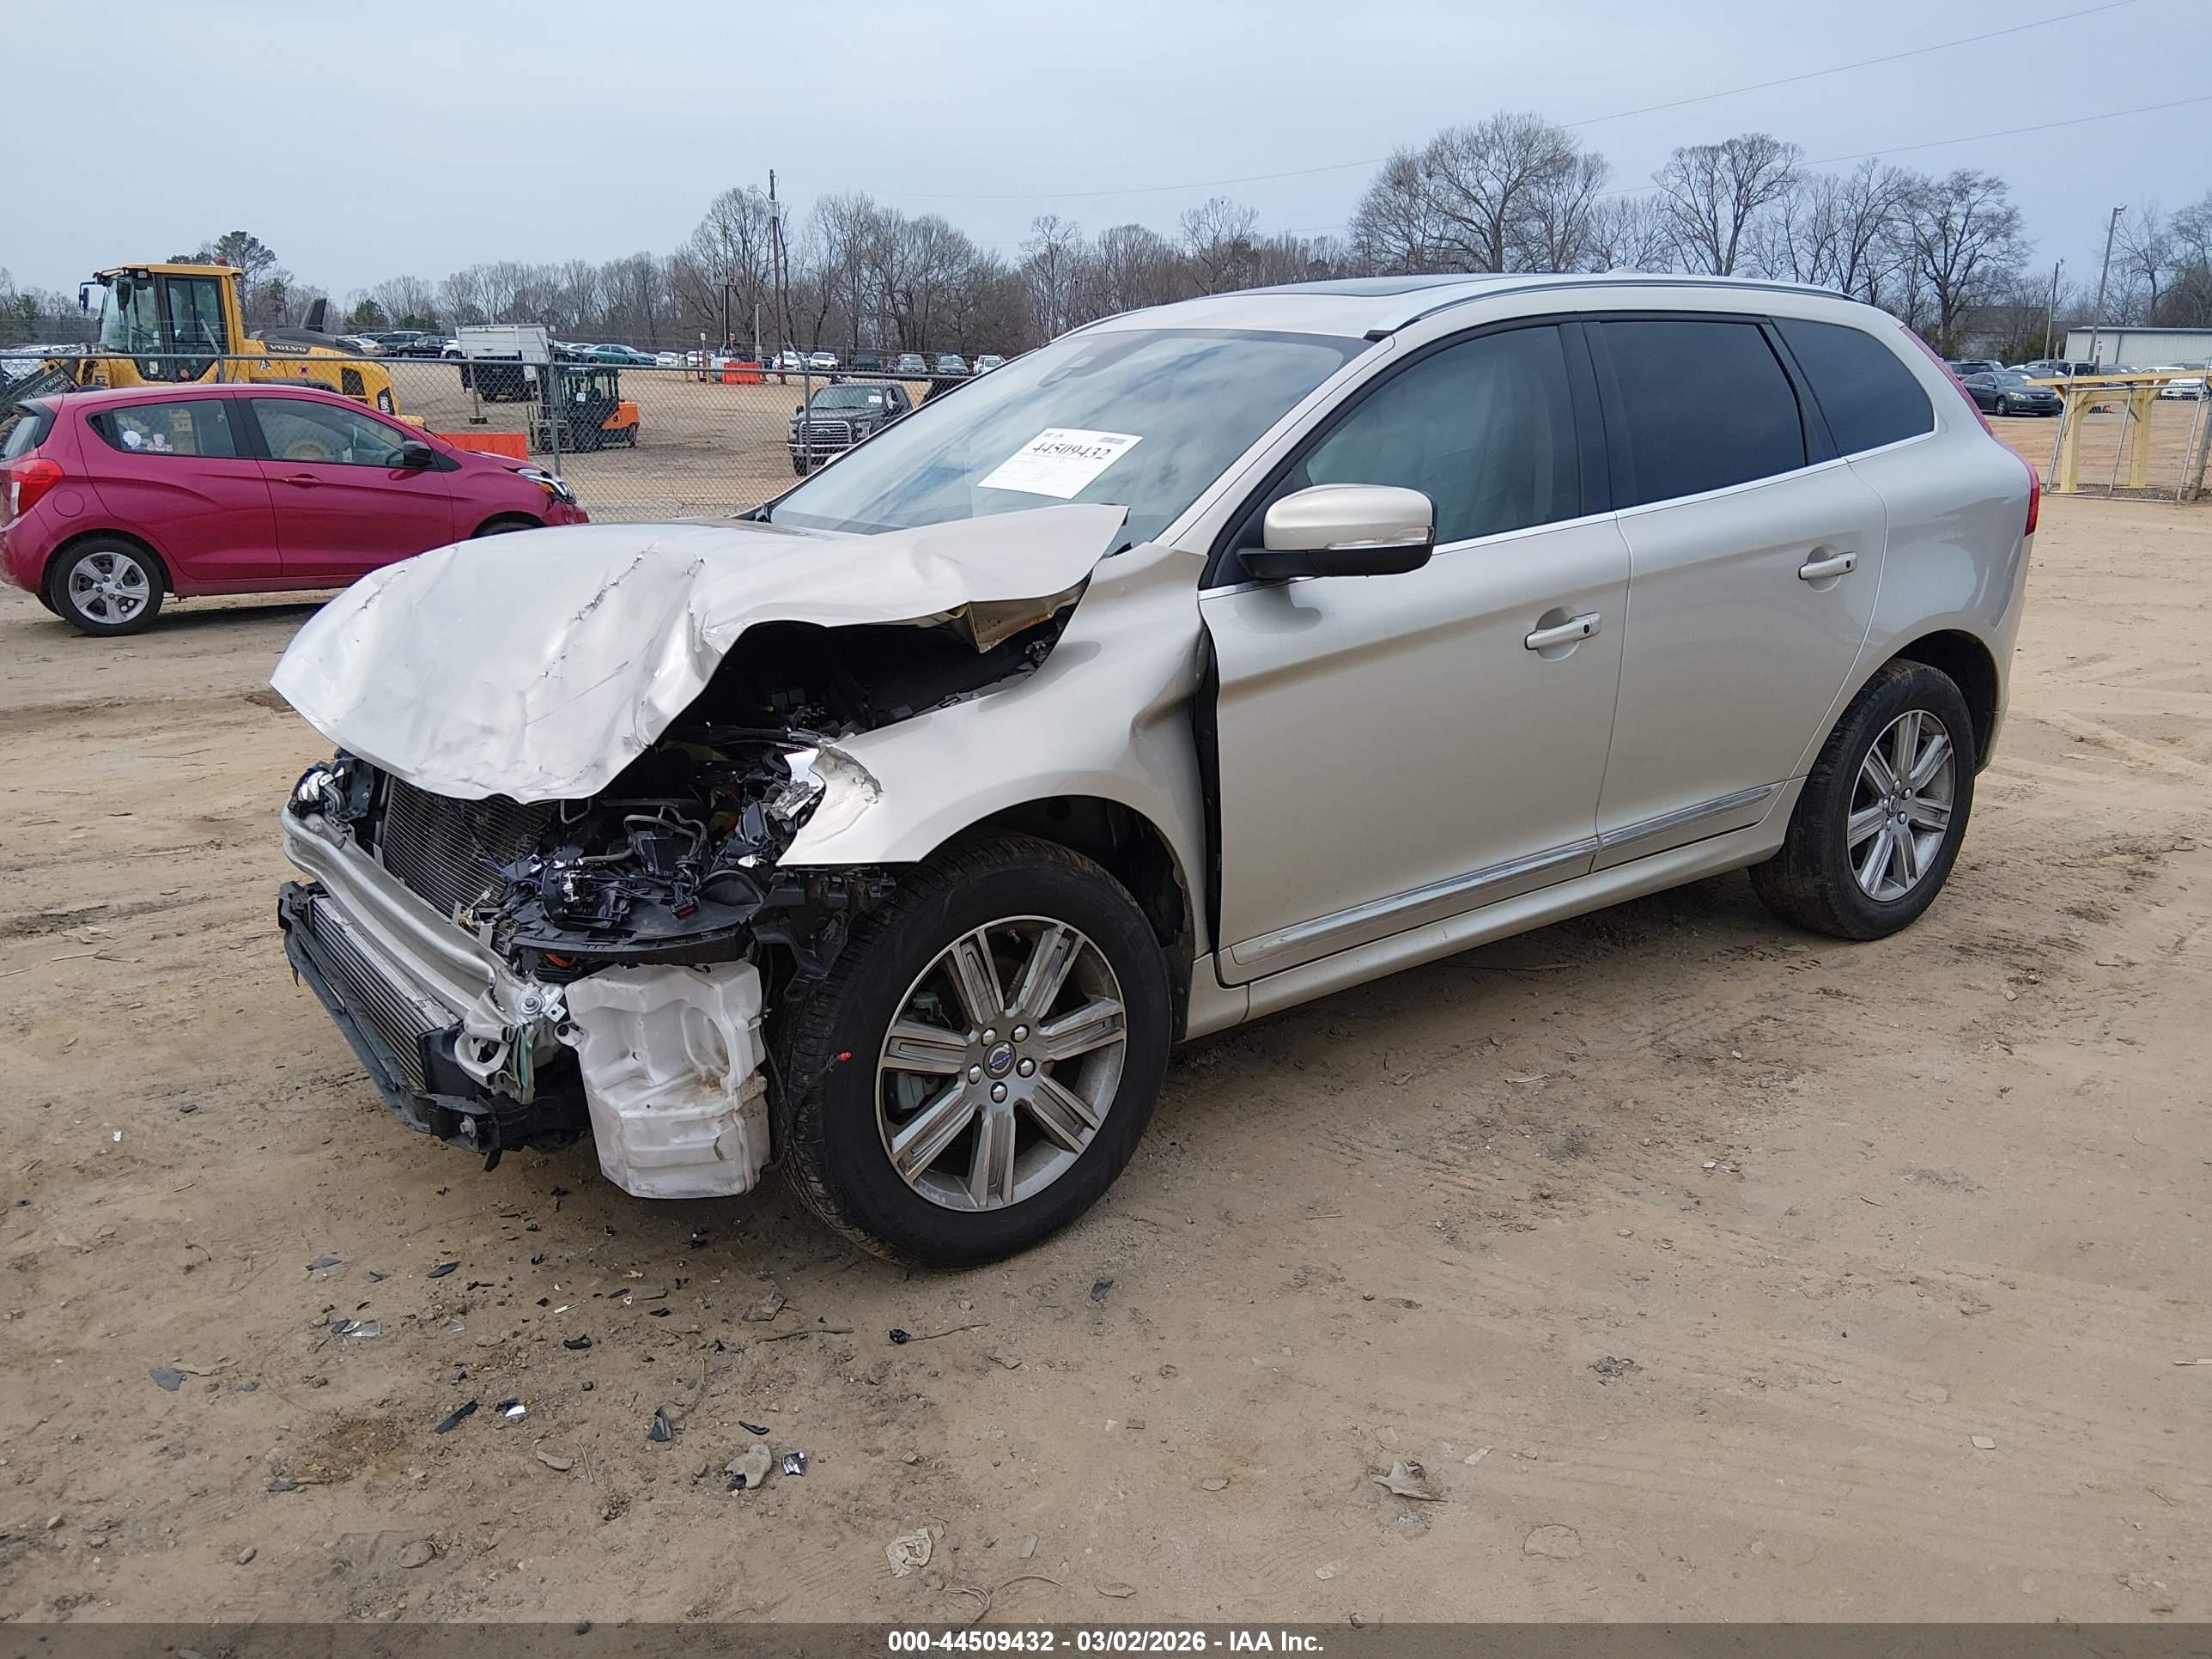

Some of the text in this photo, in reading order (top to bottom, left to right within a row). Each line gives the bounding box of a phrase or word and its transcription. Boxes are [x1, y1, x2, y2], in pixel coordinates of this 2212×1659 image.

[33, 384, 47, 397] NOT
[46, 373, 67, 387] WALK
[1032, 442, 1112, 459] 44509432
